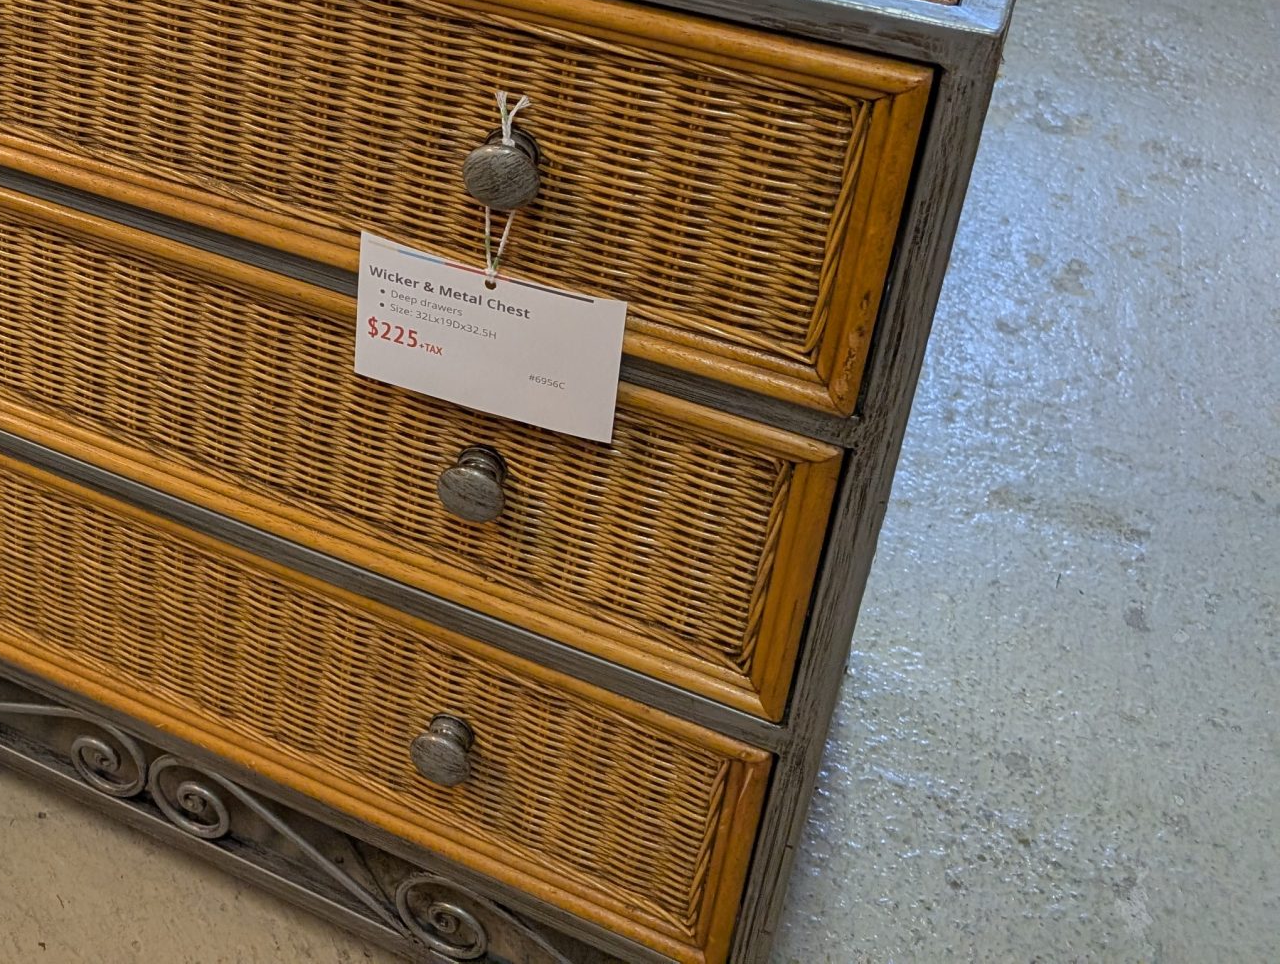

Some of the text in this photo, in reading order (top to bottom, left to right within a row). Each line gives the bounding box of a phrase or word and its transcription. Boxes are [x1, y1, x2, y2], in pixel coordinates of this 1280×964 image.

[369, 264, 531, 320] Wicker & Metal Chest
[390, 289, 464, 317] Deep drawers
[389, 303, 498, 340] Size: 32Lx19Dx32.5H
[527, 373, 567, 391] #6956C
